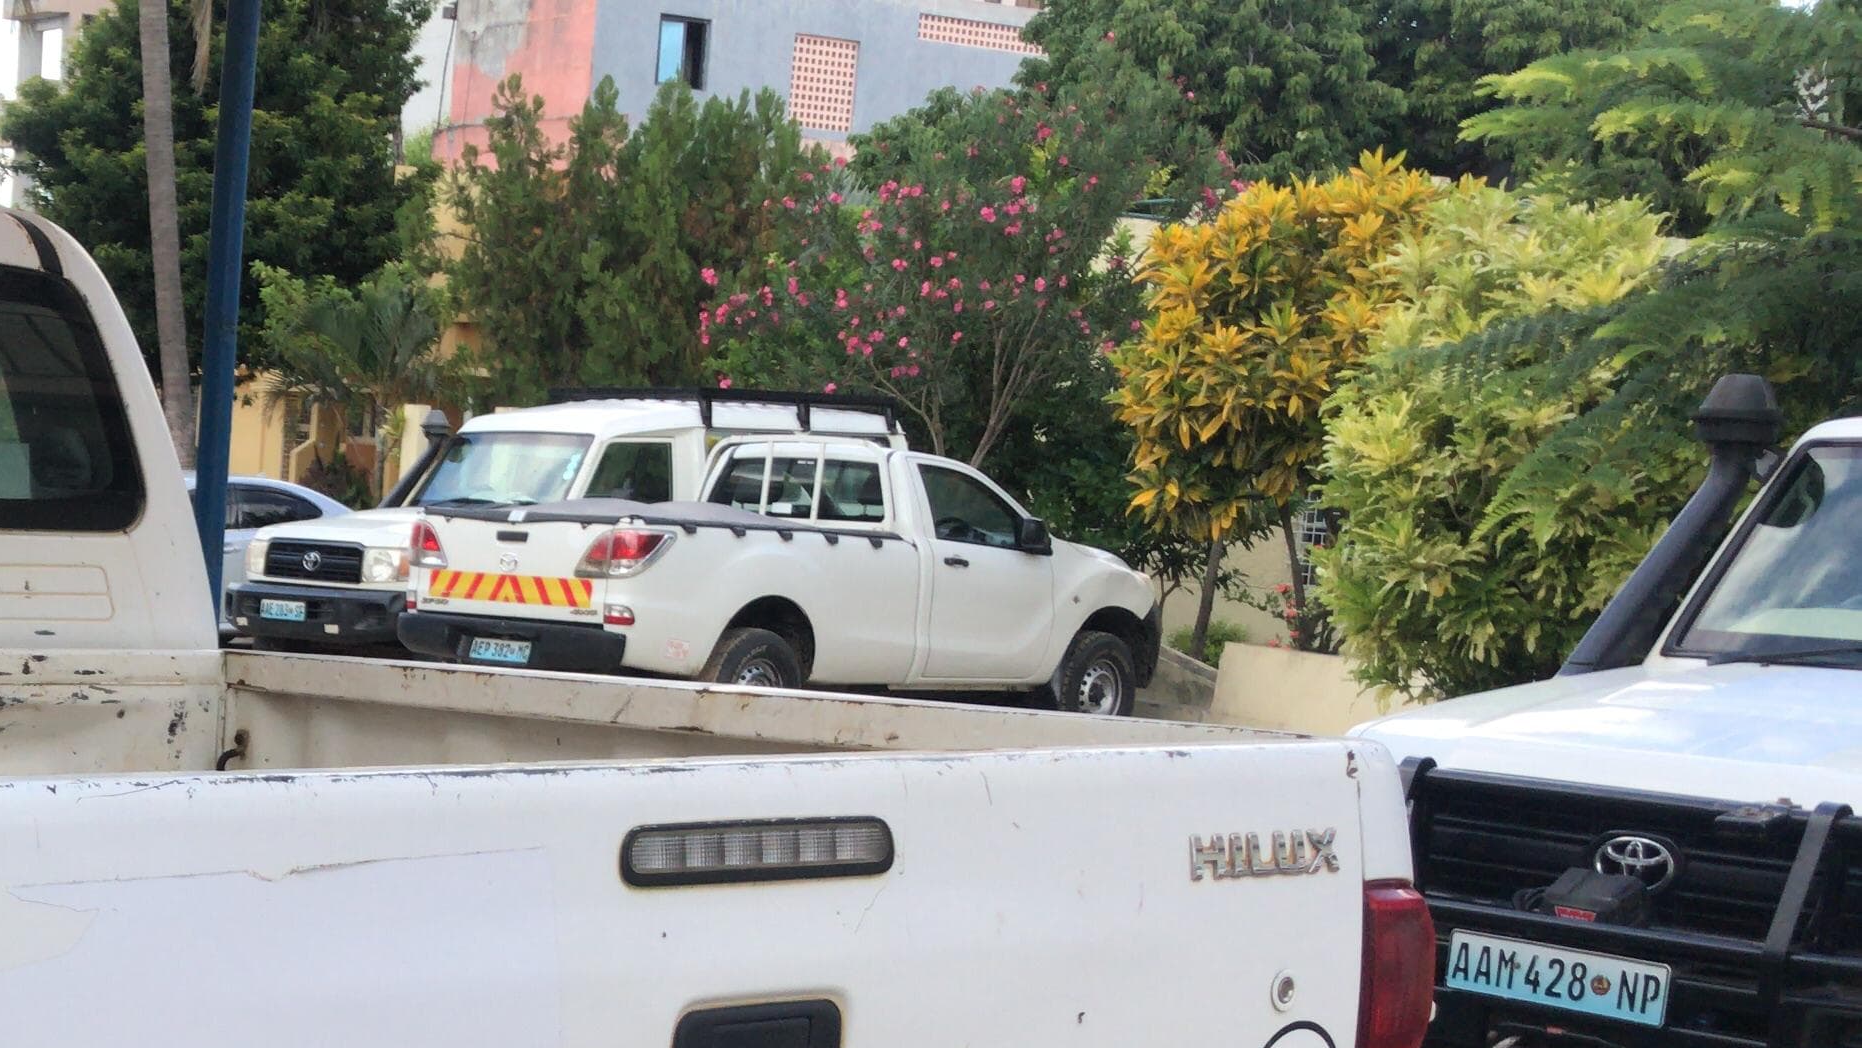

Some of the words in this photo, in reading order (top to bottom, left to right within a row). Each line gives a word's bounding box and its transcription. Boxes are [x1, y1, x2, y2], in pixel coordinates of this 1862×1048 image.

[492, 642, 511, 658] 382
[1188, 827, 1340, 881] HILUX
[1451, 942, 1517, 990] AAM
[1524, 954, 1588, 1002] 428
[1616, 969, 1661, 1014] NP
